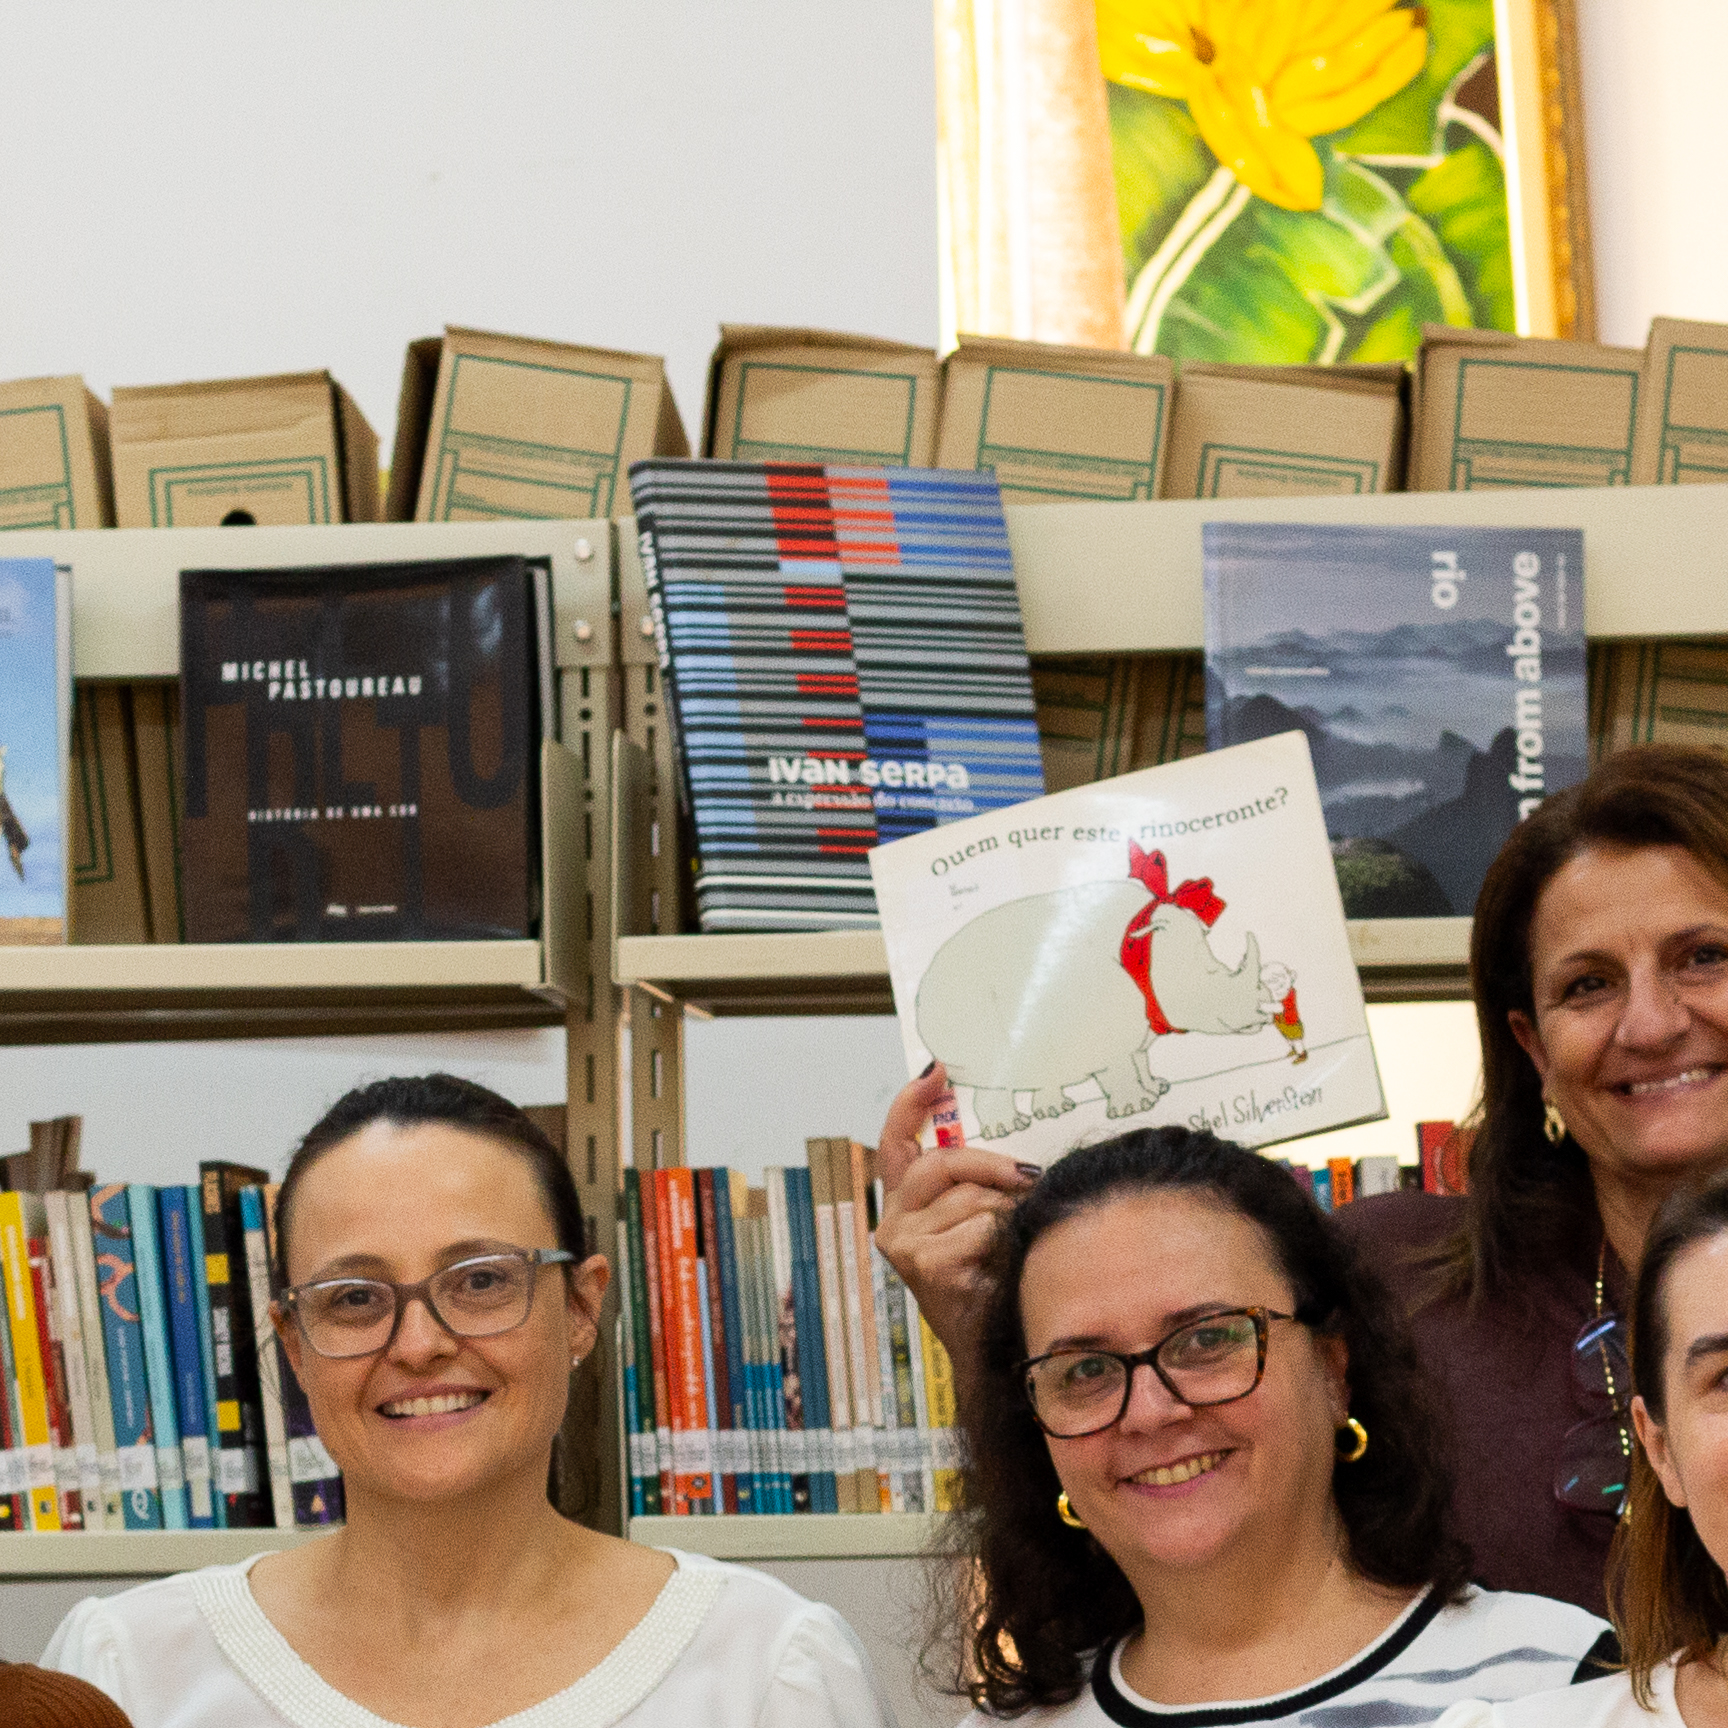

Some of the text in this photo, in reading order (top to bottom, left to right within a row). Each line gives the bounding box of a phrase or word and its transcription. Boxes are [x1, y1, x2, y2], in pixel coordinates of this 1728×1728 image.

[1430, 551, 1467, 610] rio
[1506, 551, 1542, 683] above
[221, 660, 310, 682] MICHEL
[267, 675, 422, 700] PASTOUREAU
[1508, 688, 1545, 792] from
[930, 786, 1290, 877] Quem quer este rinoceronte?
